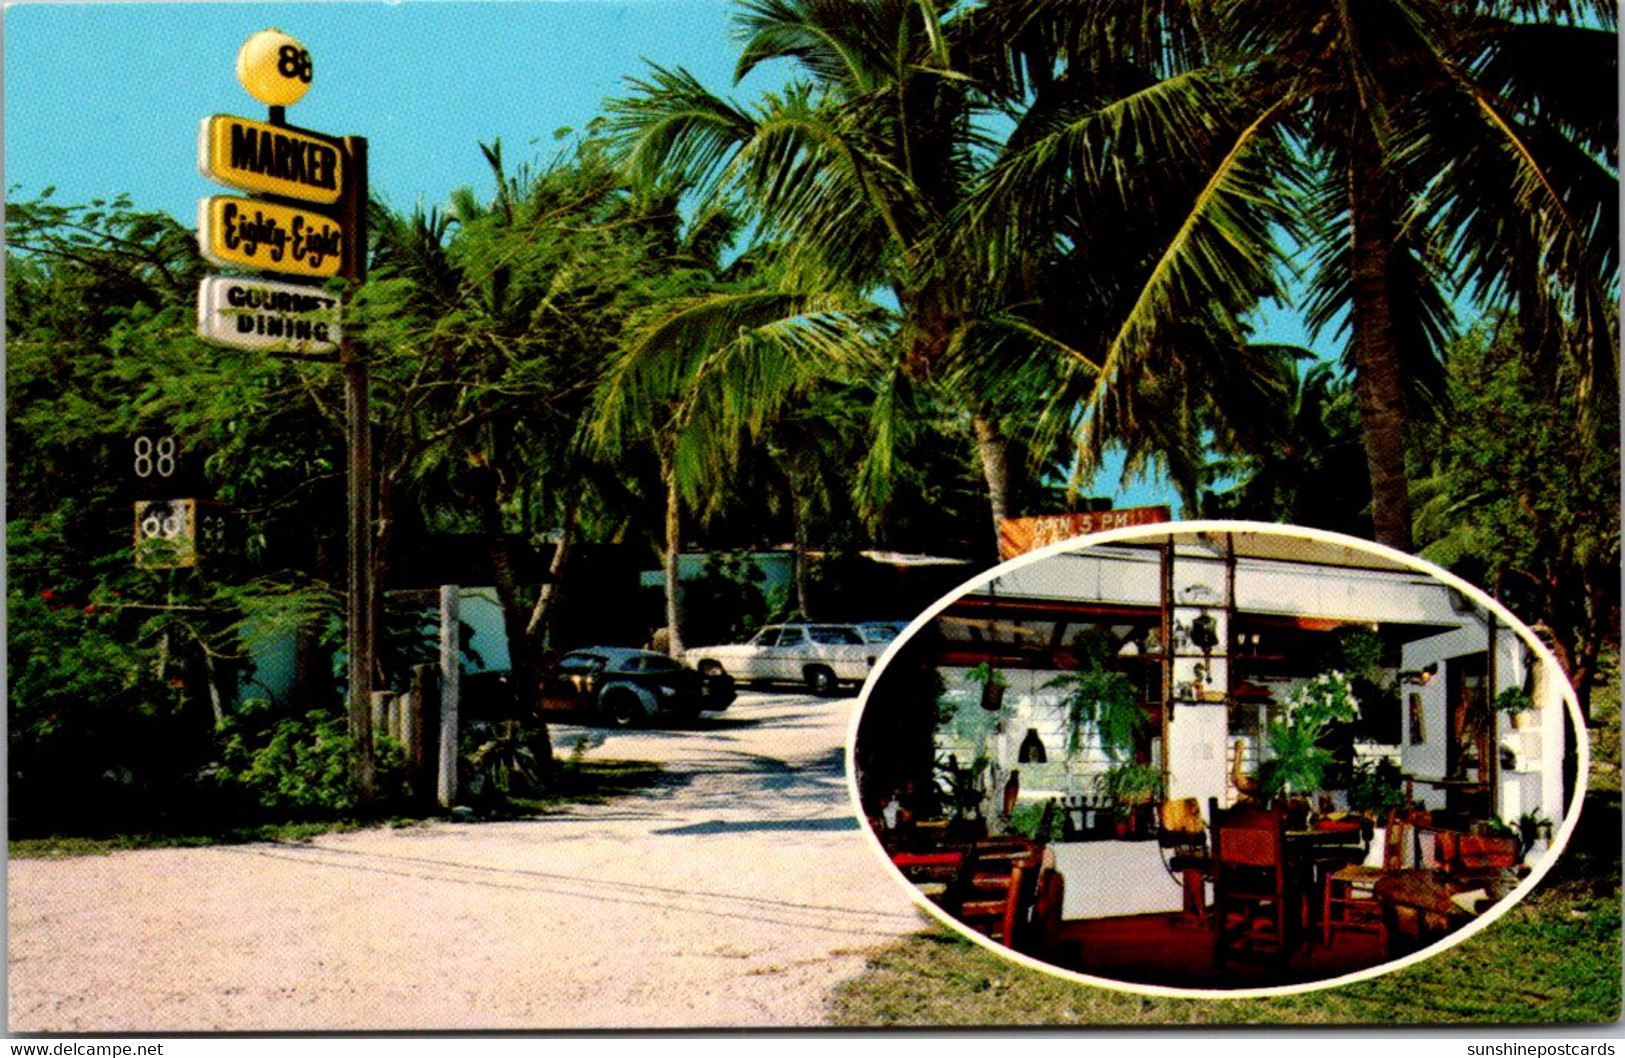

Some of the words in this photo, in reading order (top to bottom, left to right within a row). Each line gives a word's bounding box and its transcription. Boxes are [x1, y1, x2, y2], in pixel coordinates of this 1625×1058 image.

[277, 45, 312, 82] 88
[230, 123, 336, 190] MARKER
[224, 203, 339, 268] Eighty-Eight
[237, 314, 329, 341] DINING
[134, 436, 174, 477] 88
[1033, 516, 1071, 536] OPEN
[1079, 515, 1092, 532] 5
[1101, 512, 1128, 530] PM
